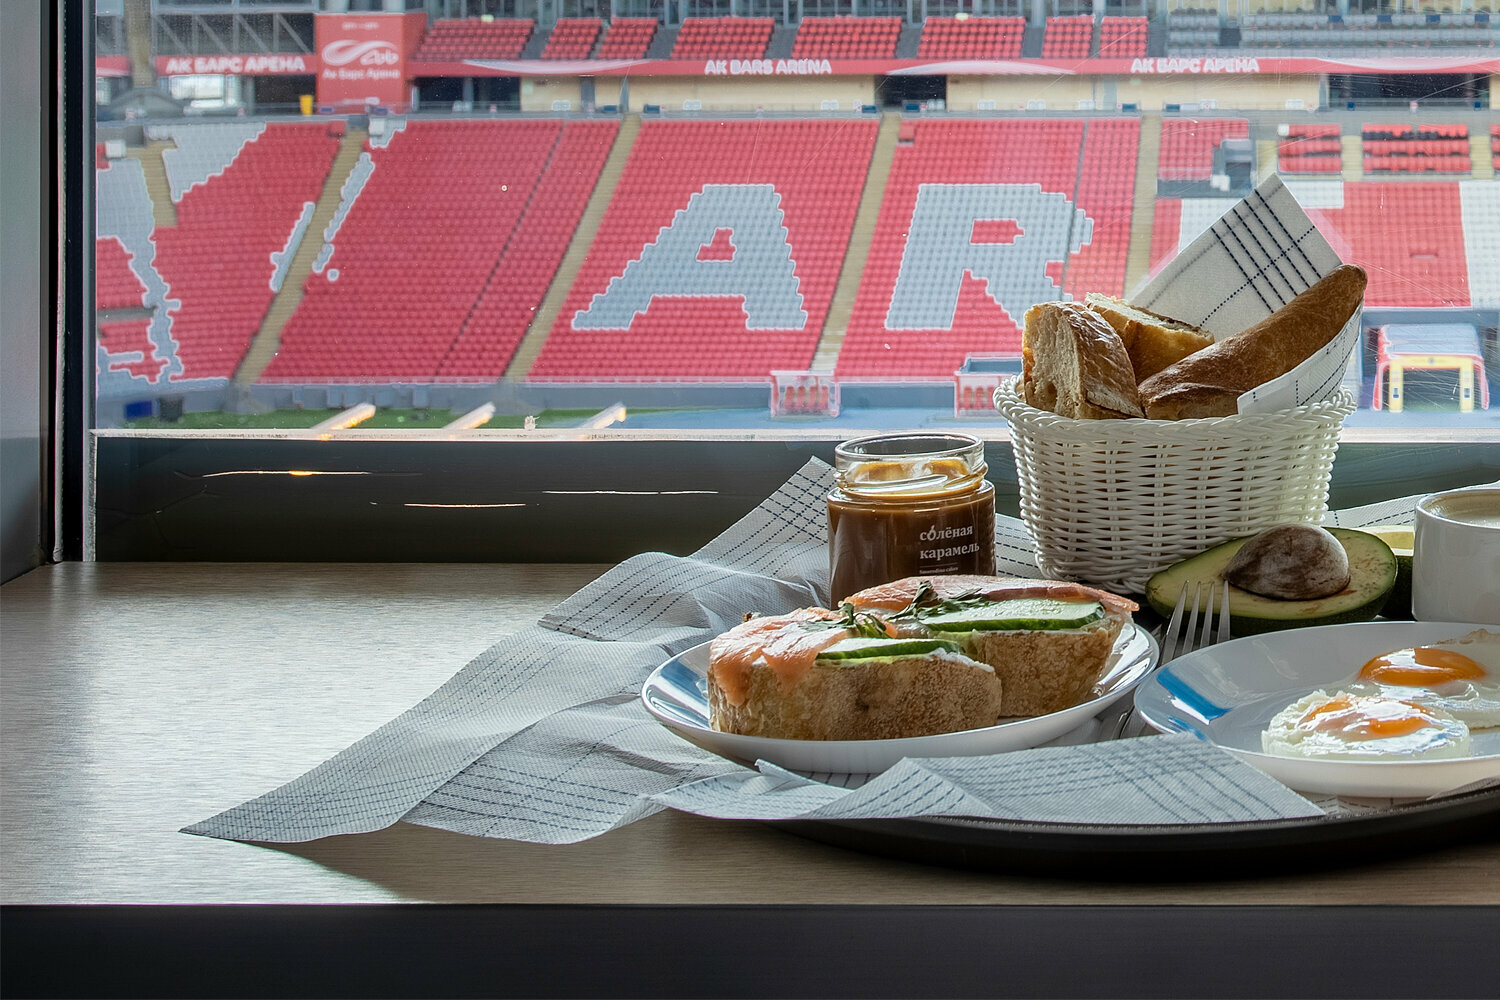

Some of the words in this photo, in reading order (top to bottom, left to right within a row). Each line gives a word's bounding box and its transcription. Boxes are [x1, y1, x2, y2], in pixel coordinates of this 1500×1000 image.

[166, 57, 193, 74] АК
[194, 57, 242, 74] БАРС
[244, 56, 306, 73] АРЕНА
[704, 59, 727, 74] AK
[730, 59, 773, 75] BARS
[775, 59, 832, 74] ARENA
[1130, 58, 1154, 73] АК
[1156, 58, 1201, 73] БАРС
[1203, 58, 1260, 73] АРЕНА
[920, 542, 980, 561] карамель
